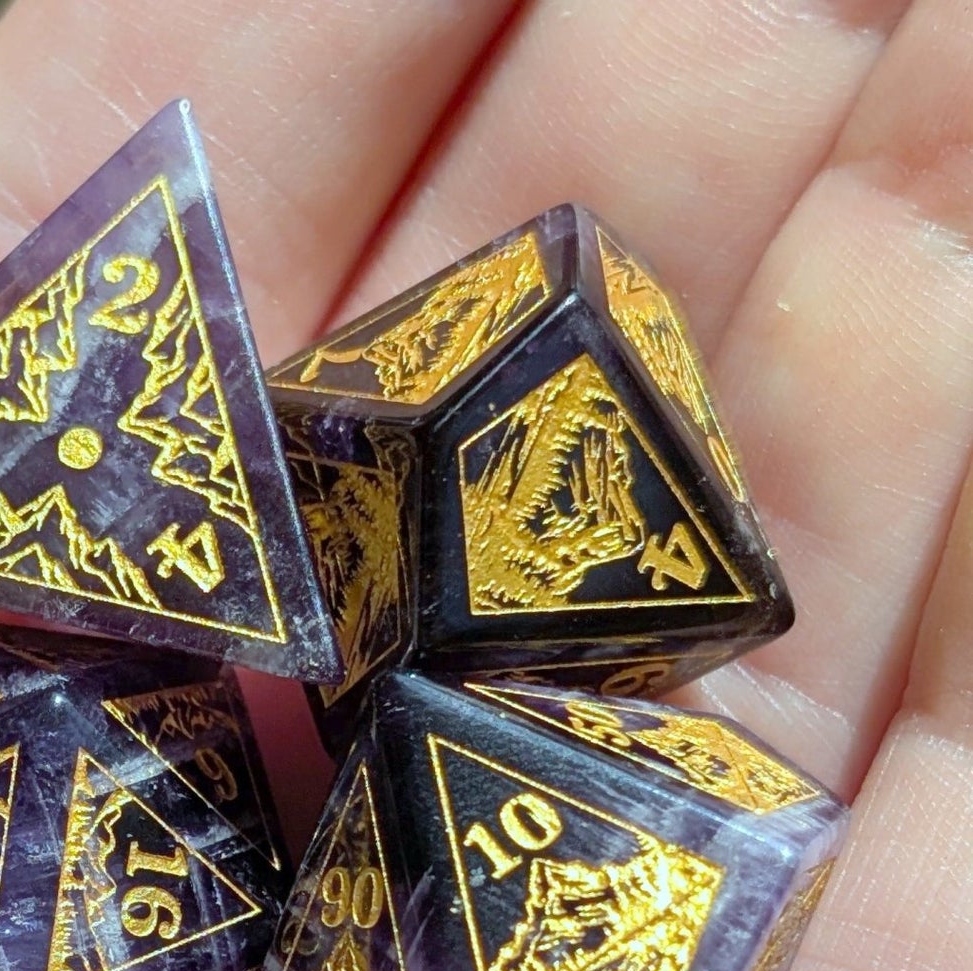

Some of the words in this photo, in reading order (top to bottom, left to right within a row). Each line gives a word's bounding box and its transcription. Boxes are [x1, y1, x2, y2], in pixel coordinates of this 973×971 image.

[88, 255, 159, 334] 2
[146, 520, 225, 593] 4
[637, 522, 710, 592] 4
[463, 793, 564, 880] 10
[120, 841, 188, 940] 16
[321, 866, 384, 929] 90
